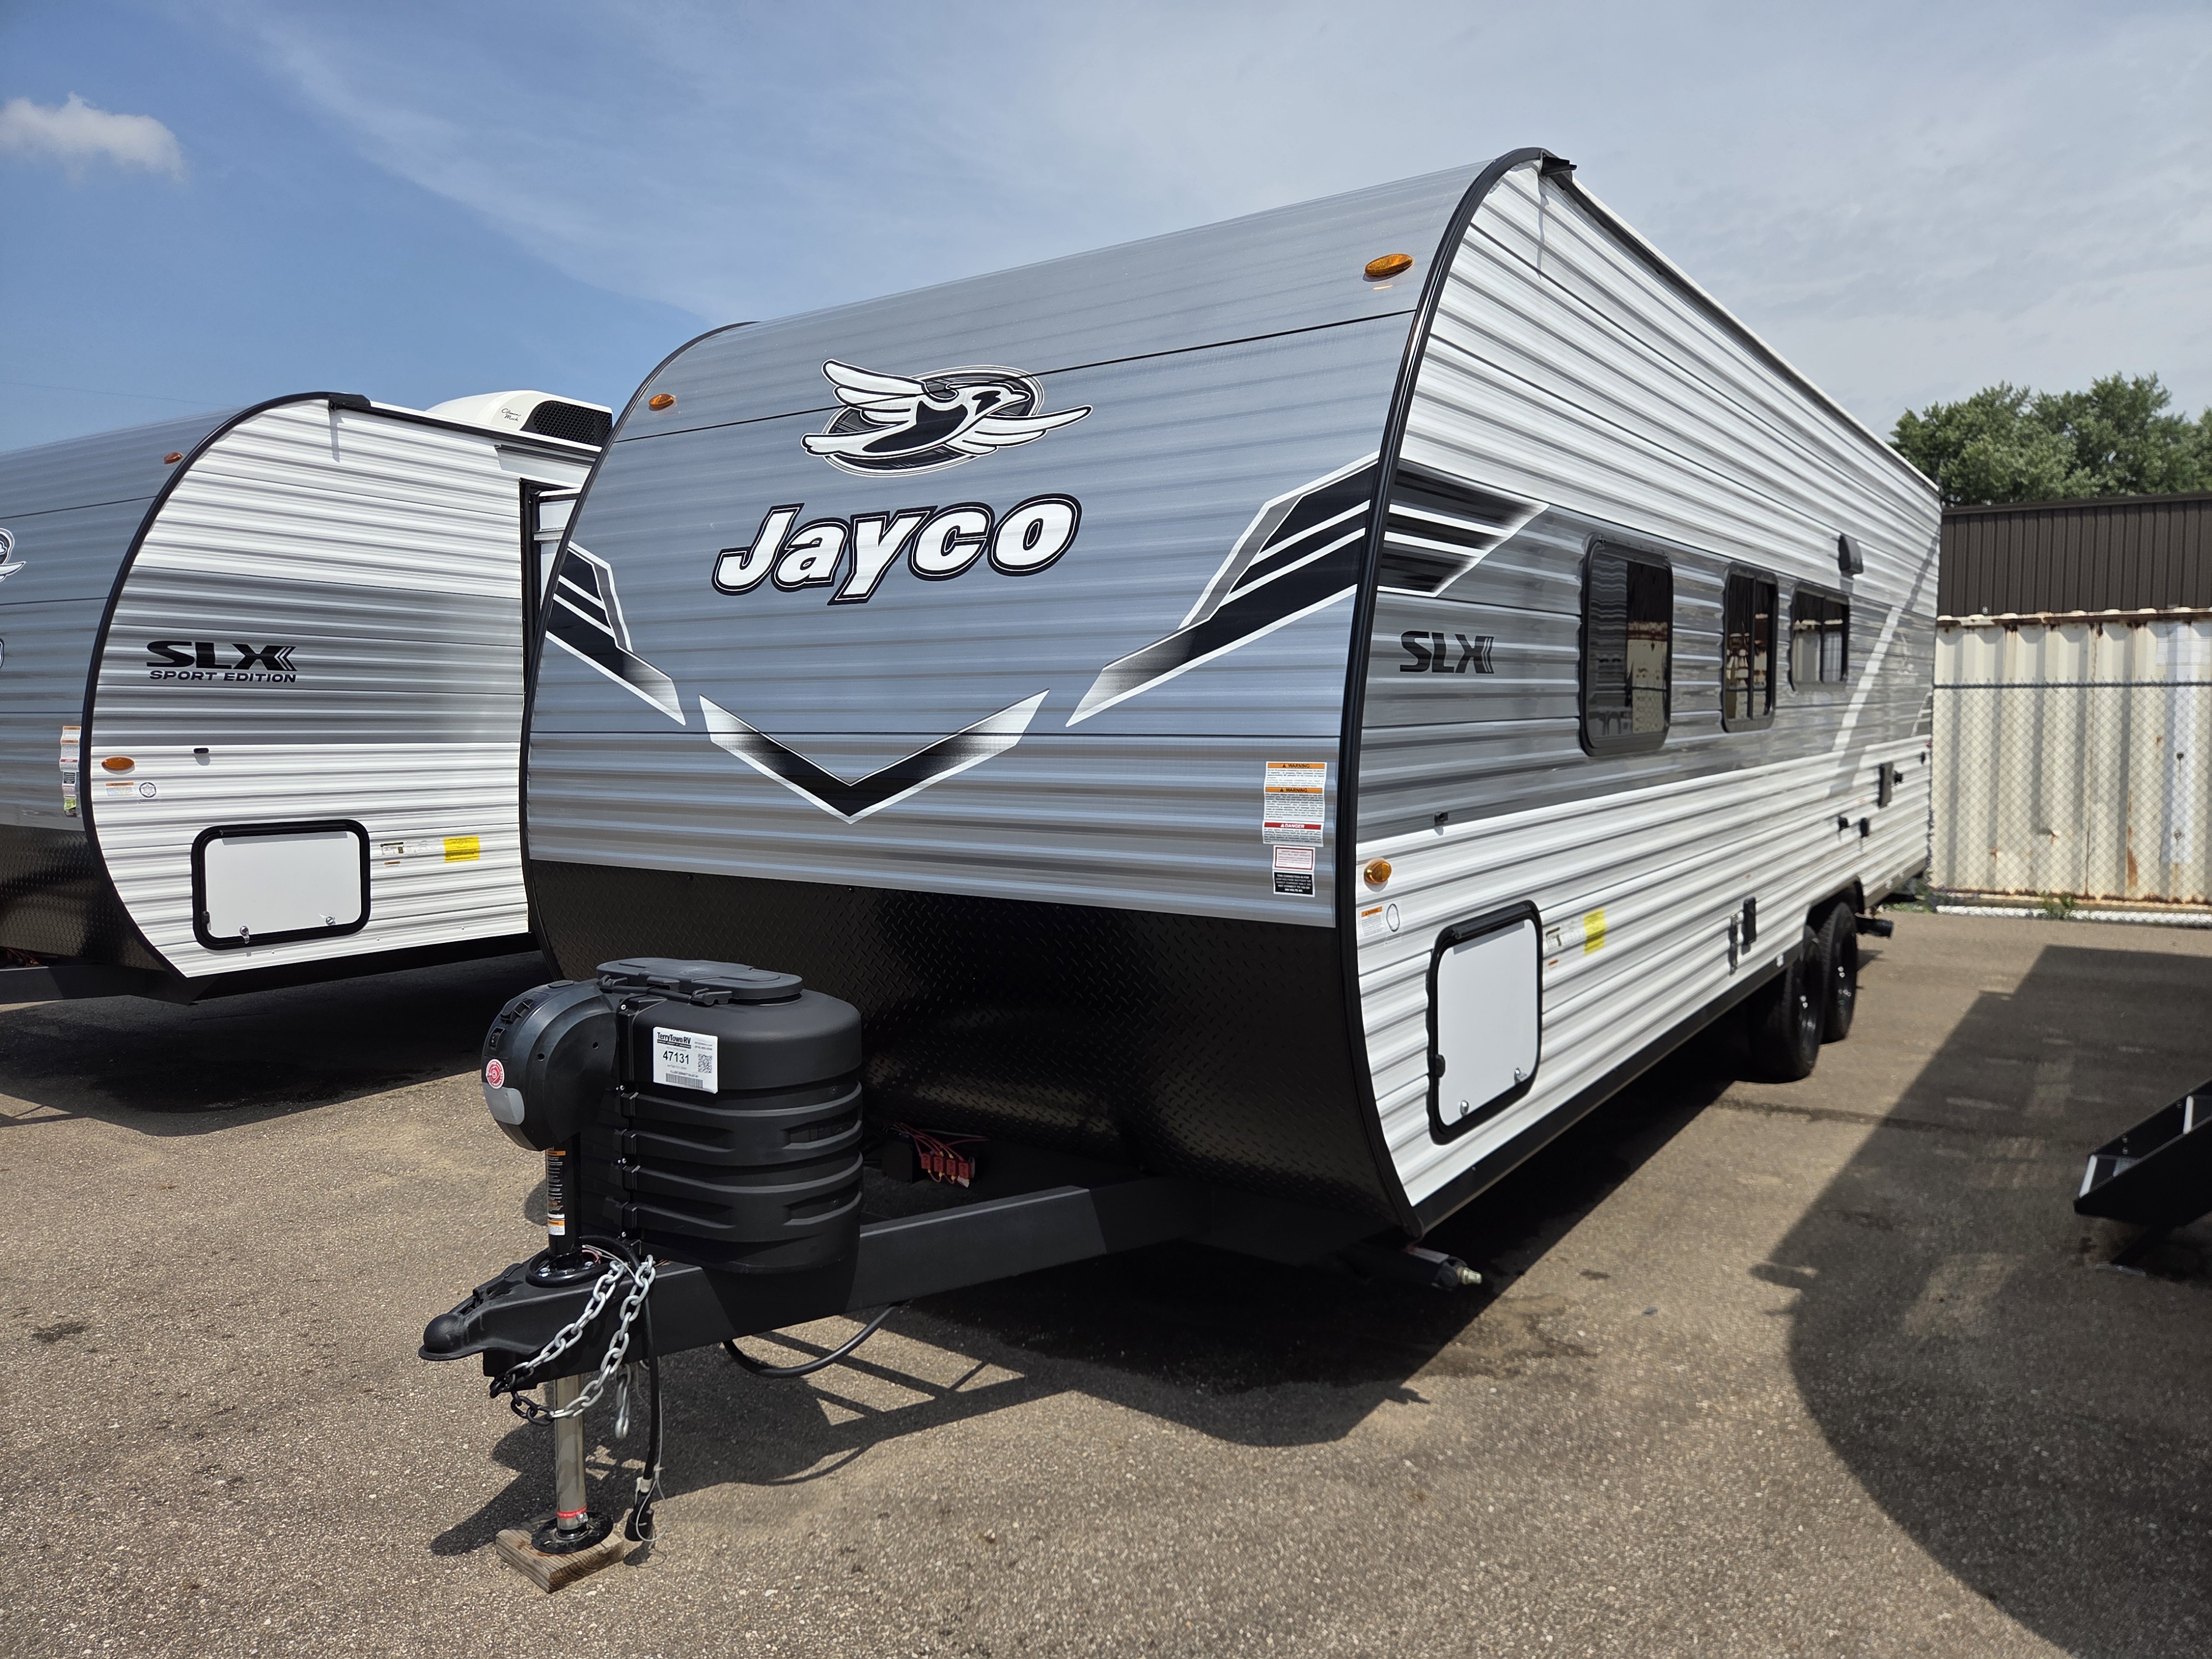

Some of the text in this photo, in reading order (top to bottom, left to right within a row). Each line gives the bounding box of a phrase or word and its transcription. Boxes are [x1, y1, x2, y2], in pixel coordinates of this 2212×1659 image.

[711, 493, 1082, 606] Jayco
[147, 640, 298, 671] SLX
[1400, 630, 1494, 674] SLX
[149, 670, 296, 683] SPORT EDITION
[663, 1050, 689, 1065] 47131
